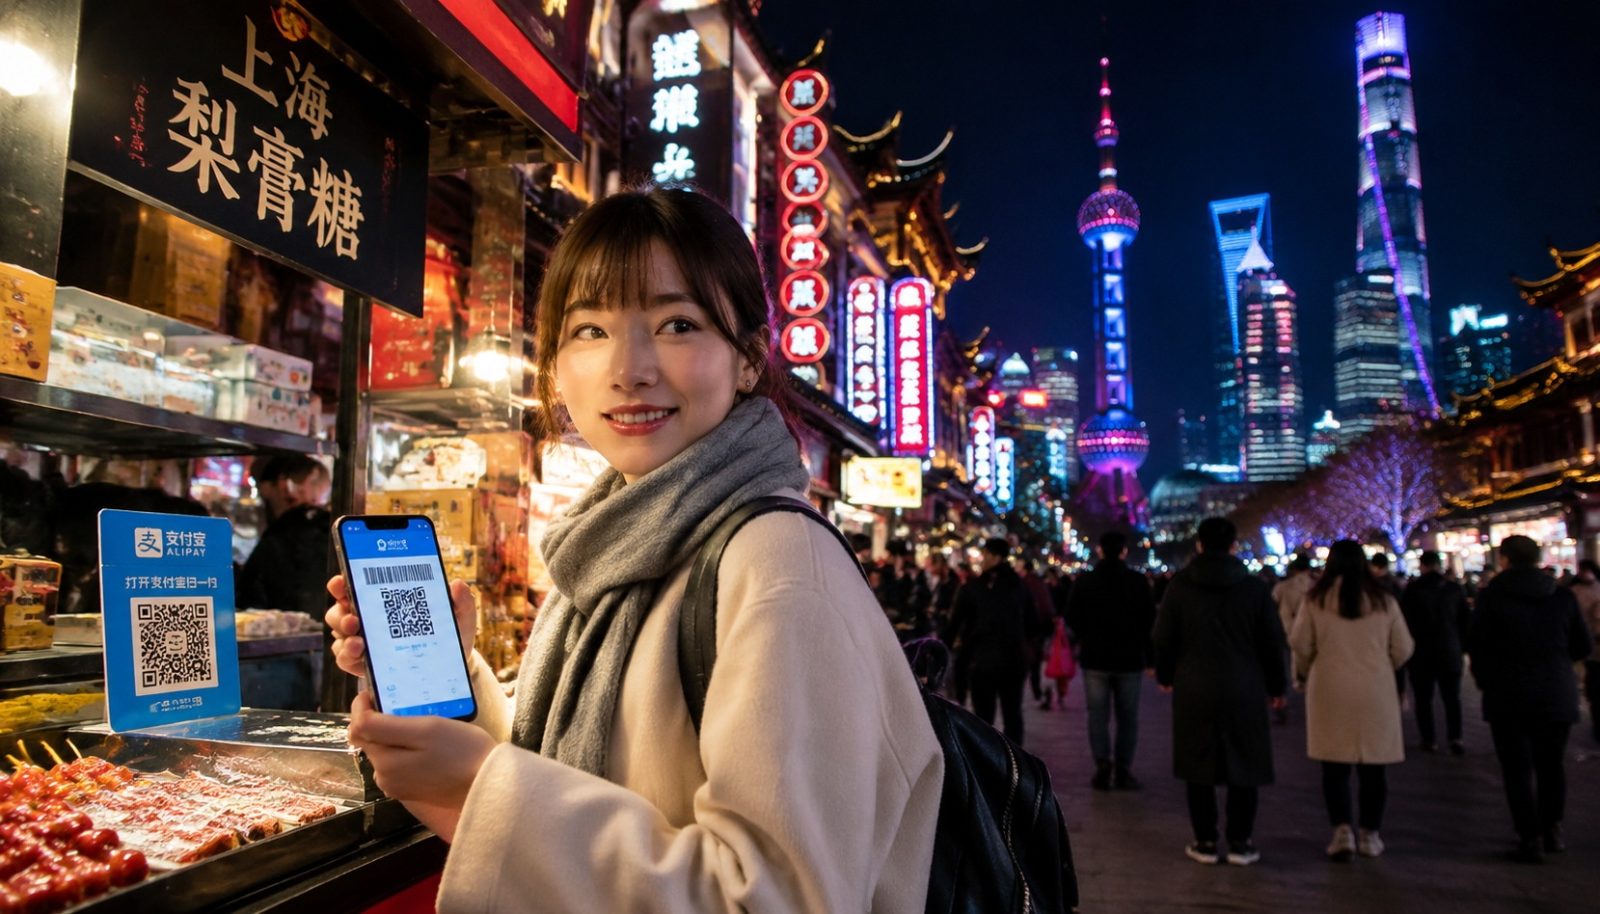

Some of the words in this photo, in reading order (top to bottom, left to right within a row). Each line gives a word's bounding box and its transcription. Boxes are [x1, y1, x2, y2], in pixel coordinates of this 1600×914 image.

[222, 15, 333, 140] 上海
[167, 77, 364, 261] 梨膏糖
[166, 531, 206, 547] 支付宝
[166, 548, 206, 557] ALIPAY
